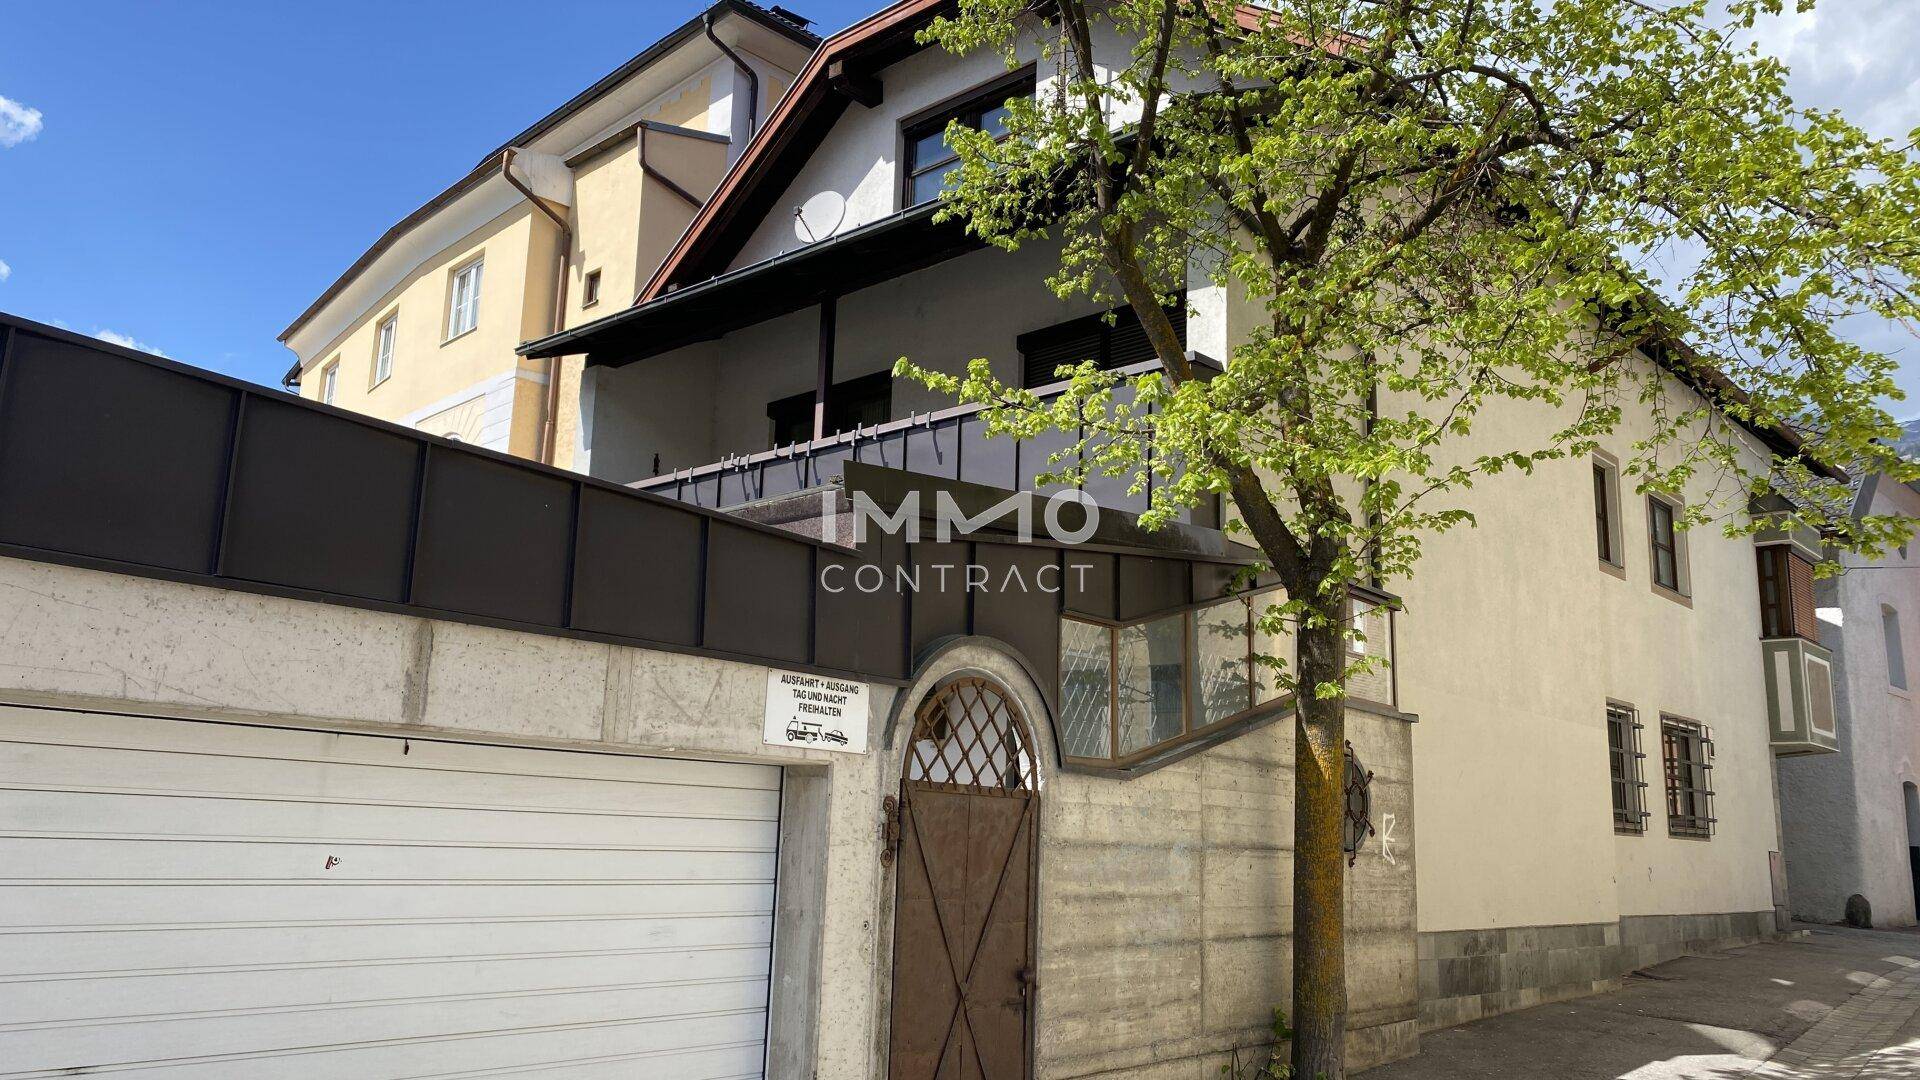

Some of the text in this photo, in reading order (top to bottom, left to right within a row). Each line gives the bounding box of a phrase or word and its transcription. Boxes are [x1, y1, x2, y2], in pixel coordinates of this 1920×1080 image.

[781, 674, 820, 688] AUSFAHRT
[826, 681, 859, 695] AUSGANG
[793, 688, 847, 706] TAG UND NACHT
[798, 702, 842, 717] FREIHALTEN
